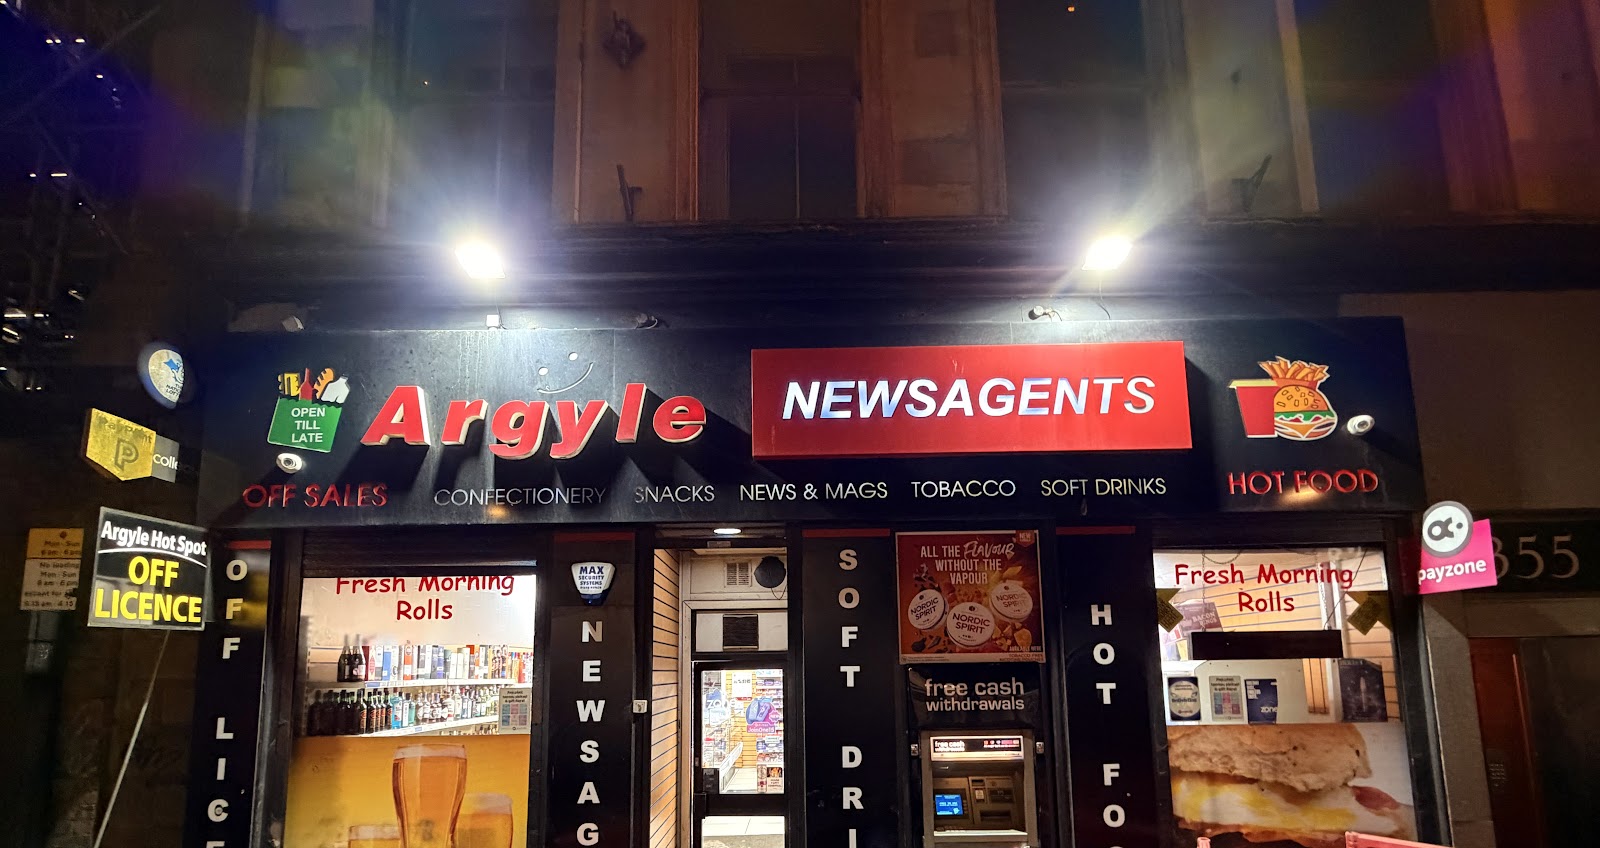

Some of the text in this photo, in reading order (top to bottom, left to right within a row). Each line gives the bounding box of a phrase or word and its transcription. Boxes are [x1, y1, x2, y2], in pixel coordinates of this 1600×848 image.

[782, 376, 1156, 420] NEWSAGENTS
[290, 406, 325, 418] OPEN
[360, 382, 706, 460] Argyle
[294, 420, 321, 431] TILL
[290, 432, 323, 443] LATE
[434, 476, 1167, 507] CONFECTIONERY SNACKS NEWS & MAGS TOBACCO SOFT DRINKS
[1227, 468, 1379, 495] HOT FOOD
[242, 483, 388, 509] OFF SALES
[101, 520, 207, 557] Argyle Hot Spot
[920, 546, 938, 558] ALL
[942, 545, 960, 558] THE
[128, 555, 179, 588] OFF
[579, 565, 604, 575] MAX
[935, 558, 1002, 572] WITHOUT THE
[1418, 558, 1487, 585] payzone
[336, 576, 515, 596] Fresh Morning
[950, 571, 988, 585] VAPOUR
[1174, 563, 1353, 590] Fresh Morning
[95, 588, 203, 624] LICENCE
[396, 598, 453, 620] Rolls
[910, 597, 939, 614] NORDIC
[915, 605, 937, 621] SPIRIT
[1238, 591, 1295, 613] Rolls
[838, 548, 861, 688] SOFT
[952, 612, 990, 627] NORDIC
[955, 622, 985, 635] SPIRIT
[1090, 604, 1117, 705] HOT
[924, 677, 1025, 697] free cash
[926, 696, 1025, 712] withdrawals
[1103, 763, 1126, 848] FO
